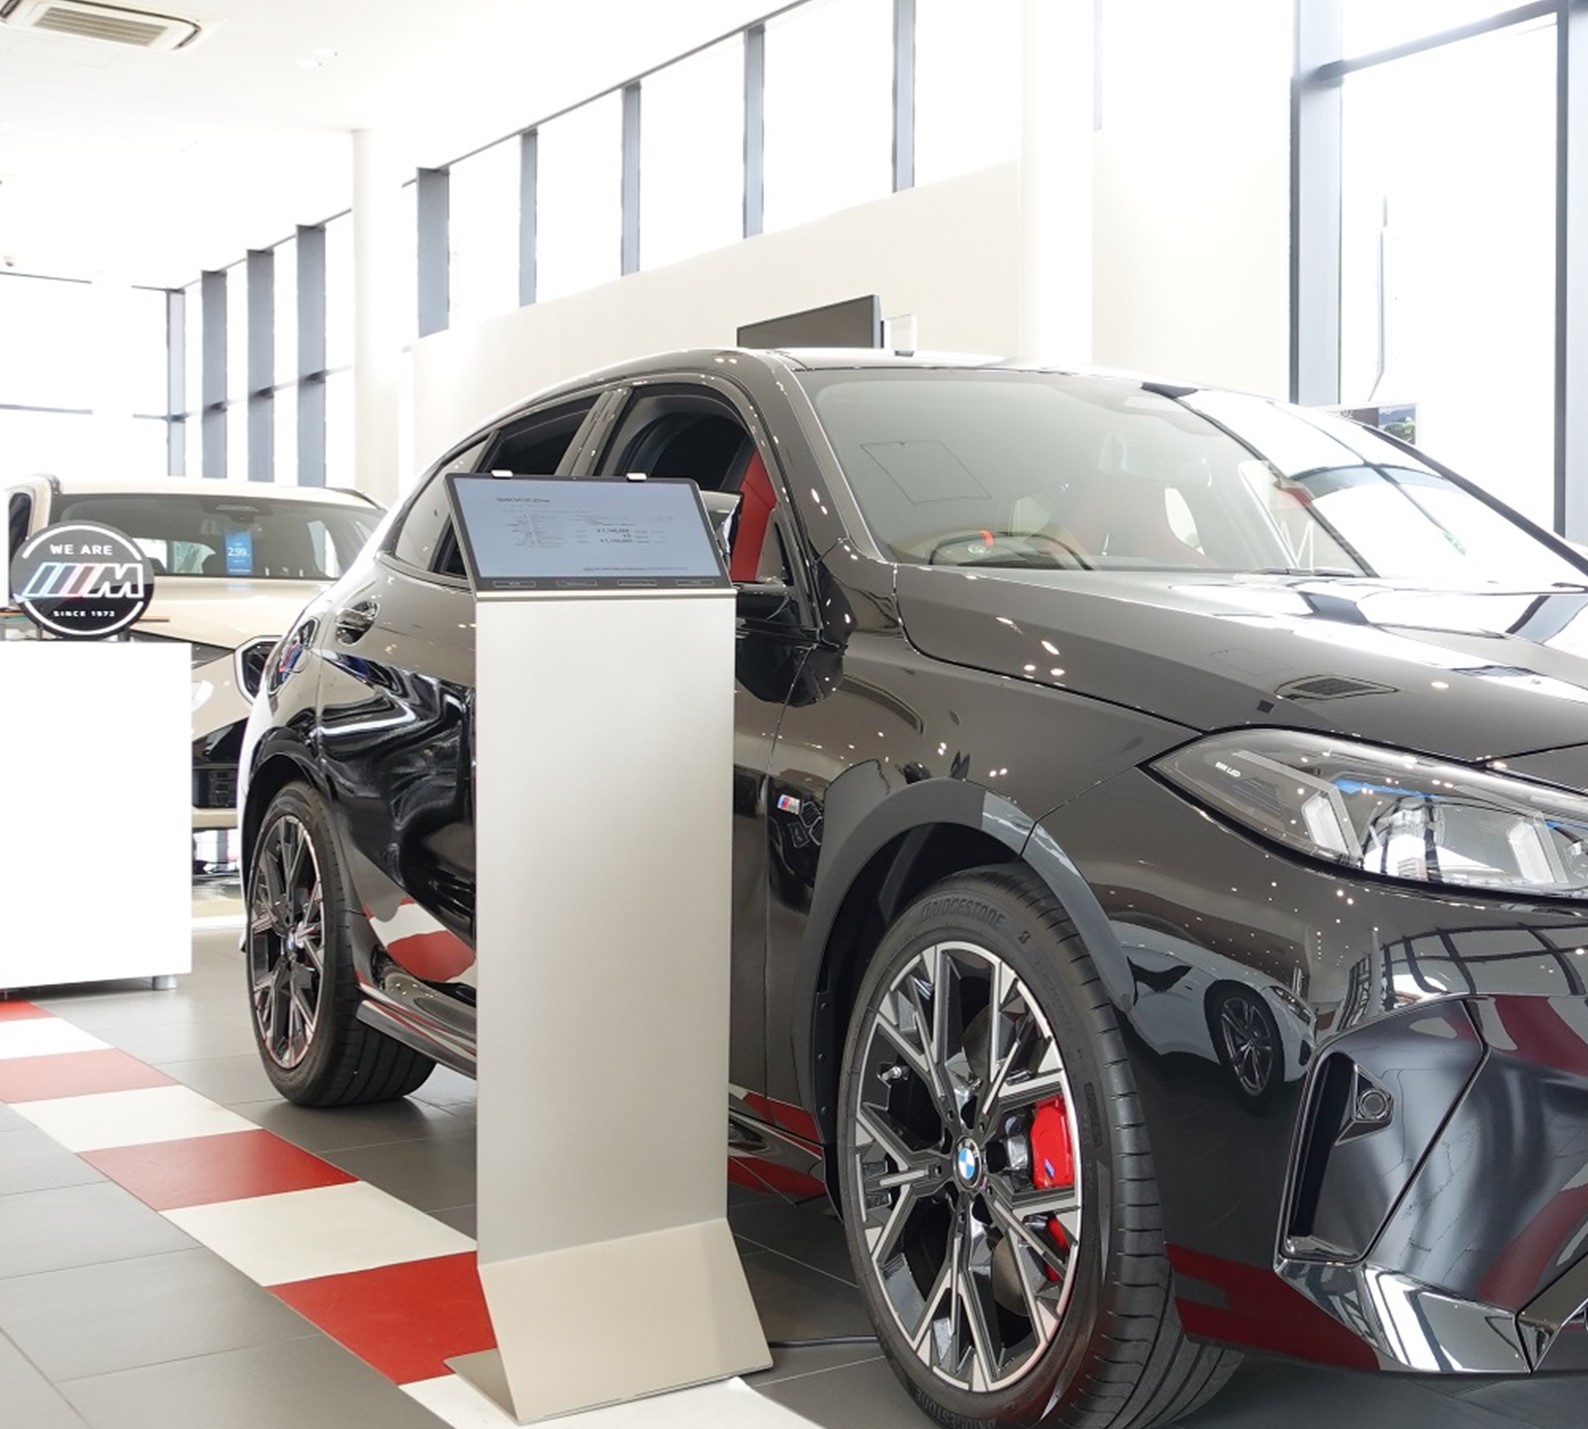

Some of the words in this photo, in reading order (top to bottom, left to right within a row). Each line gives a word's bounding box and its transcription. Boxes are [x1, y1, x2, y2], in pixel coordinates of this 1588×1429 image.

[50, 544, 74, 555] WE
[80, 544, 113, 556] ARE
[53, 610, 86, 618] SINCE
